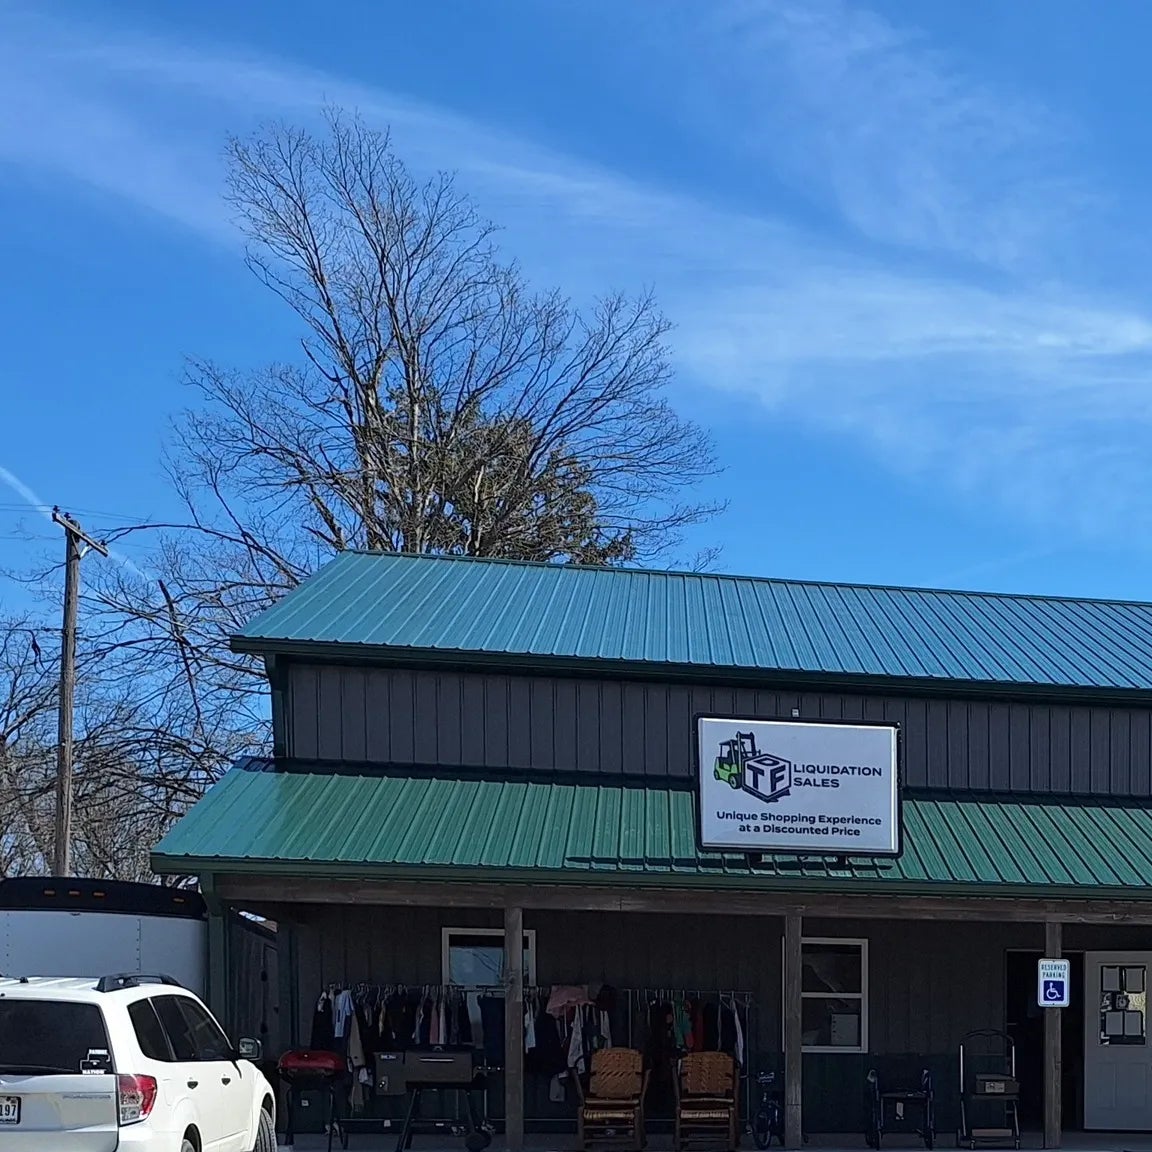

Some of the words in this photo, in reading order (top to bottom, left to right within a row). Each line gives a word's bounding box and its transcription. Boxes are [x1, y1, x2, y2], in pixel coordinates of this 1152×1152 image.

[793, 764, 882, 777] LIQUIDATION
[793, 777, 840, 788] SALES
[716, 811, 758, 822] Unique
[760, 812, 816, 824] Shopping
[819, 815, 882, 825] Experience
[738, 824, 751, 832] at
[763, 825, 829, 835] Discounted
[831, 827, 861, 836] Price
[1042, 971, 1065, 979] PARKING
